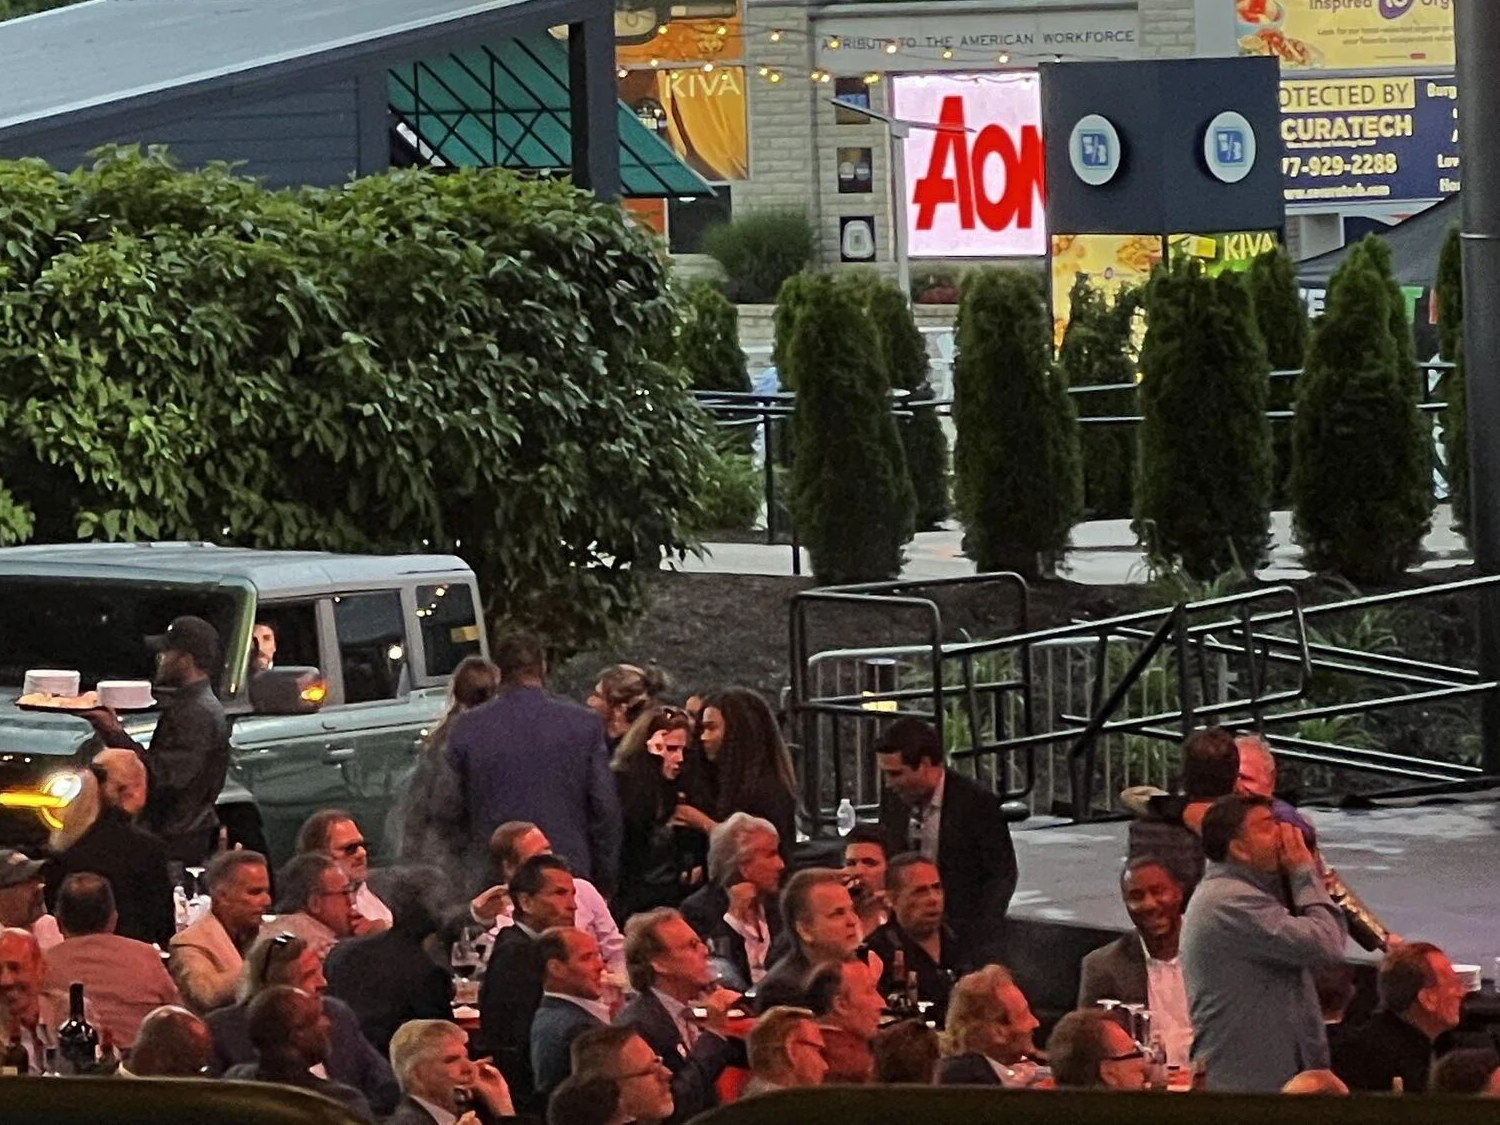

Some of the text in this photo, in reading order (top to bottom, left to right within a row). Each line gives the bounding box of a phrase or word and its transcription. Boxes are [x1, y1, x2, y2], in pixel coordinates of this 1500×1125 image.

[832, 36, 894, 50] RIBUT
[898, 36, 917, 48] TO
[925, 36, 954, 48] THE
[960, 33, 1034, 47] AMERICAN
[1042, 30, 1136, 44] WORKFORCE
[665, 74, 740, 99] KIVA
[1383, 83, 1409, 103] BY
[1224, 233, 1273, 261] KIVA
